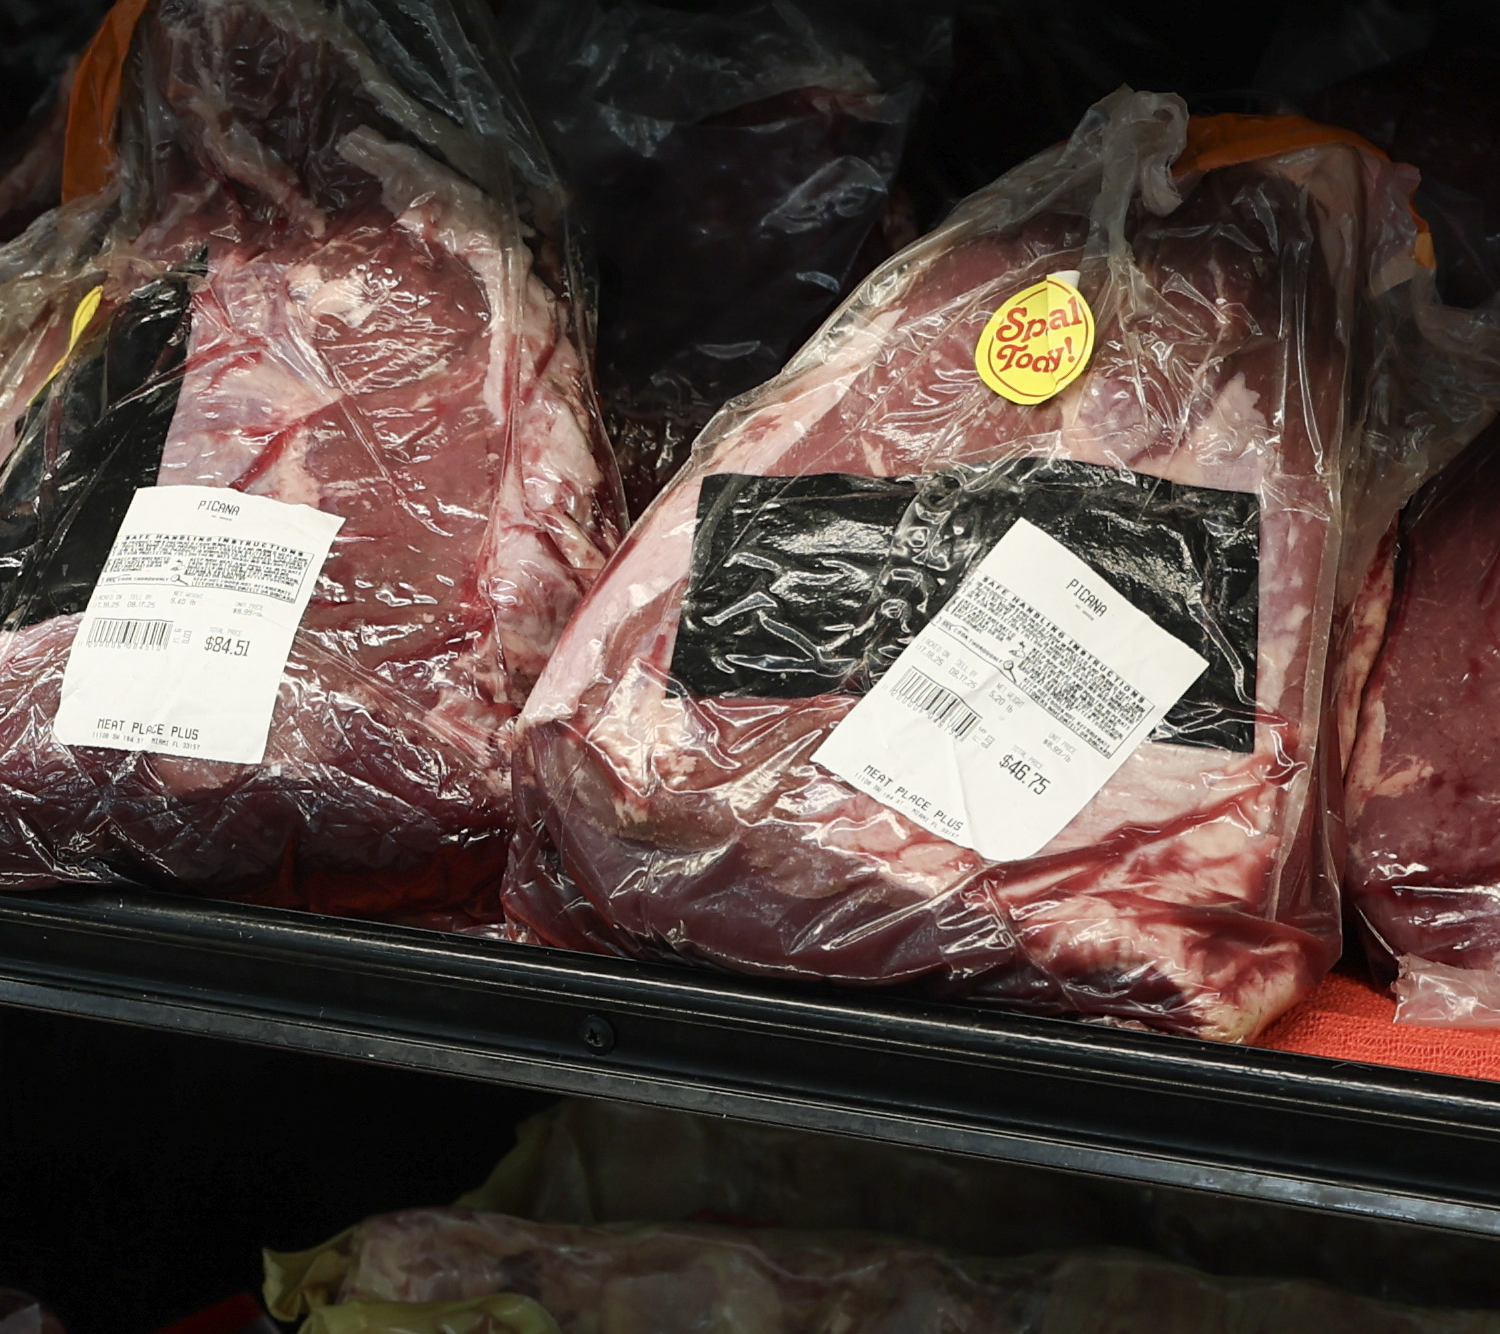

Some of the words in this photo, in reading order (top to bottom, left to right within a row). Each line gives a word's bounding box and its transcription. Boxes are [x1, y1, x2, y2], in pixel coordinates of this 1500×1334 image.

[197, 499, 241, 517] PICANA
[1066, 577, 1109, 617] PICANA
[203, 636, 251, 658] $84.51
[96, 718, 126, 731] MEAT
[131, 721, 165, 736] PLACE
[170, 727, 200, 741] PLUS
[999, 753, 1052, 797] $46.75
[862, 763, 894, 788] MEAT
[894, 785, 932, 812] PLACE
[932, 809, 965, 832] PLUS
